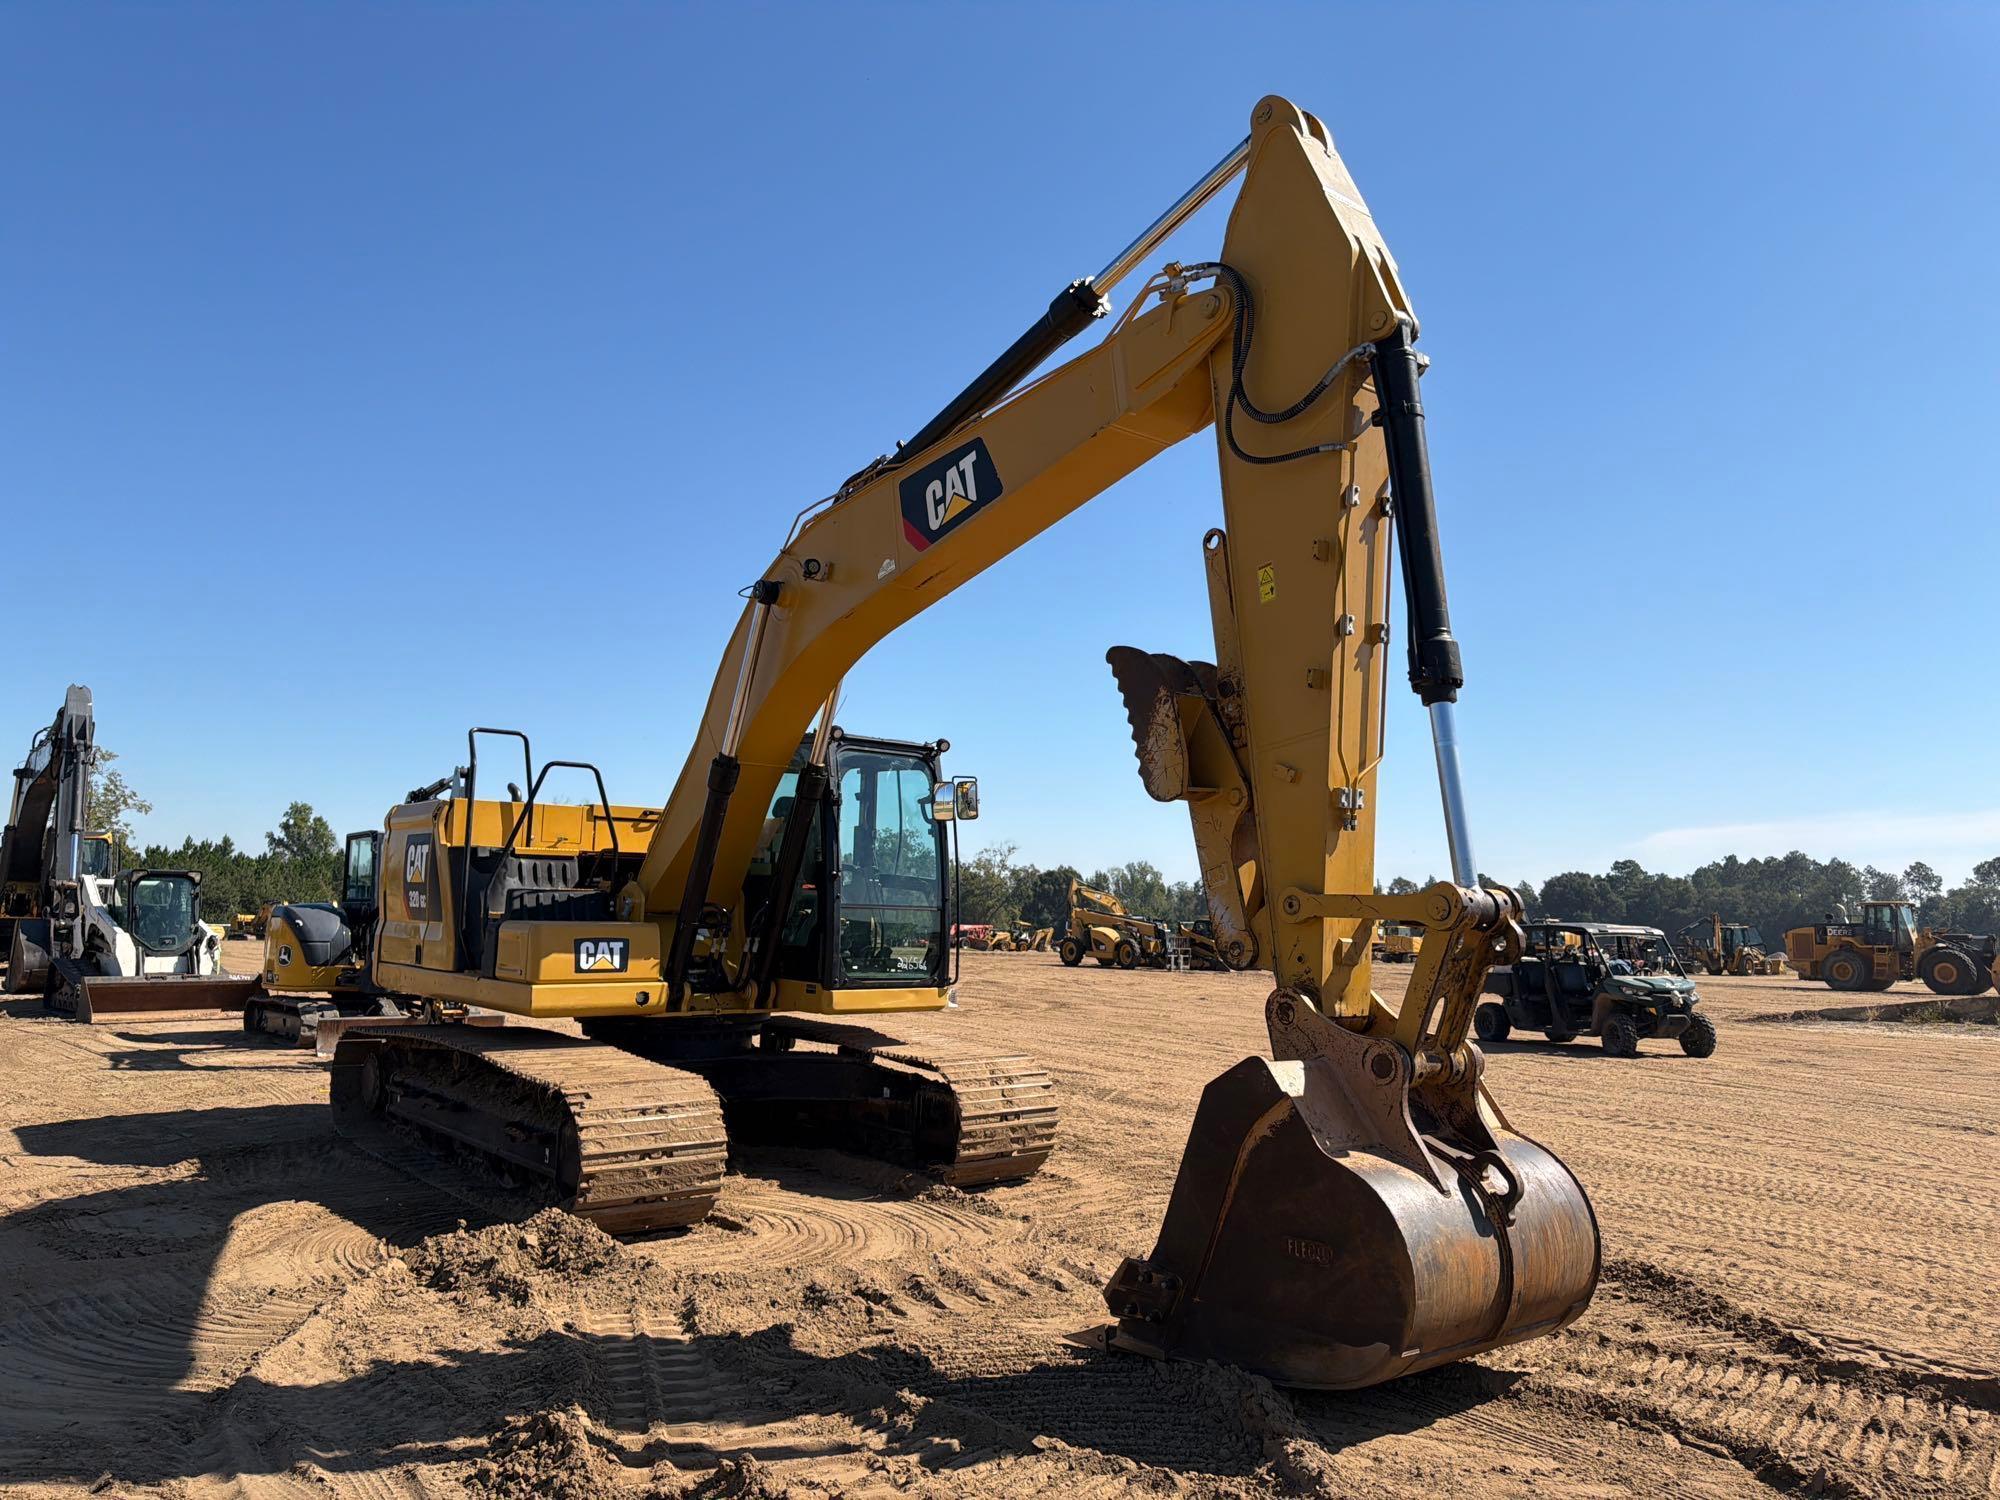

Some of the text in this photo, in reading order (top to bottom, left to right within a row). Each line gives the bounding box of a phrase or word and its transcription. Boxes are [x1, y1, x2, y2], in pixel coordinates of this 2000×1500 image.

[925, 449, 977, 531] CAT
[406, 844, 429, 883] CAT
[1827, 928, 1852, 936] DEERE
[580, 941, 624, 970] CAT
